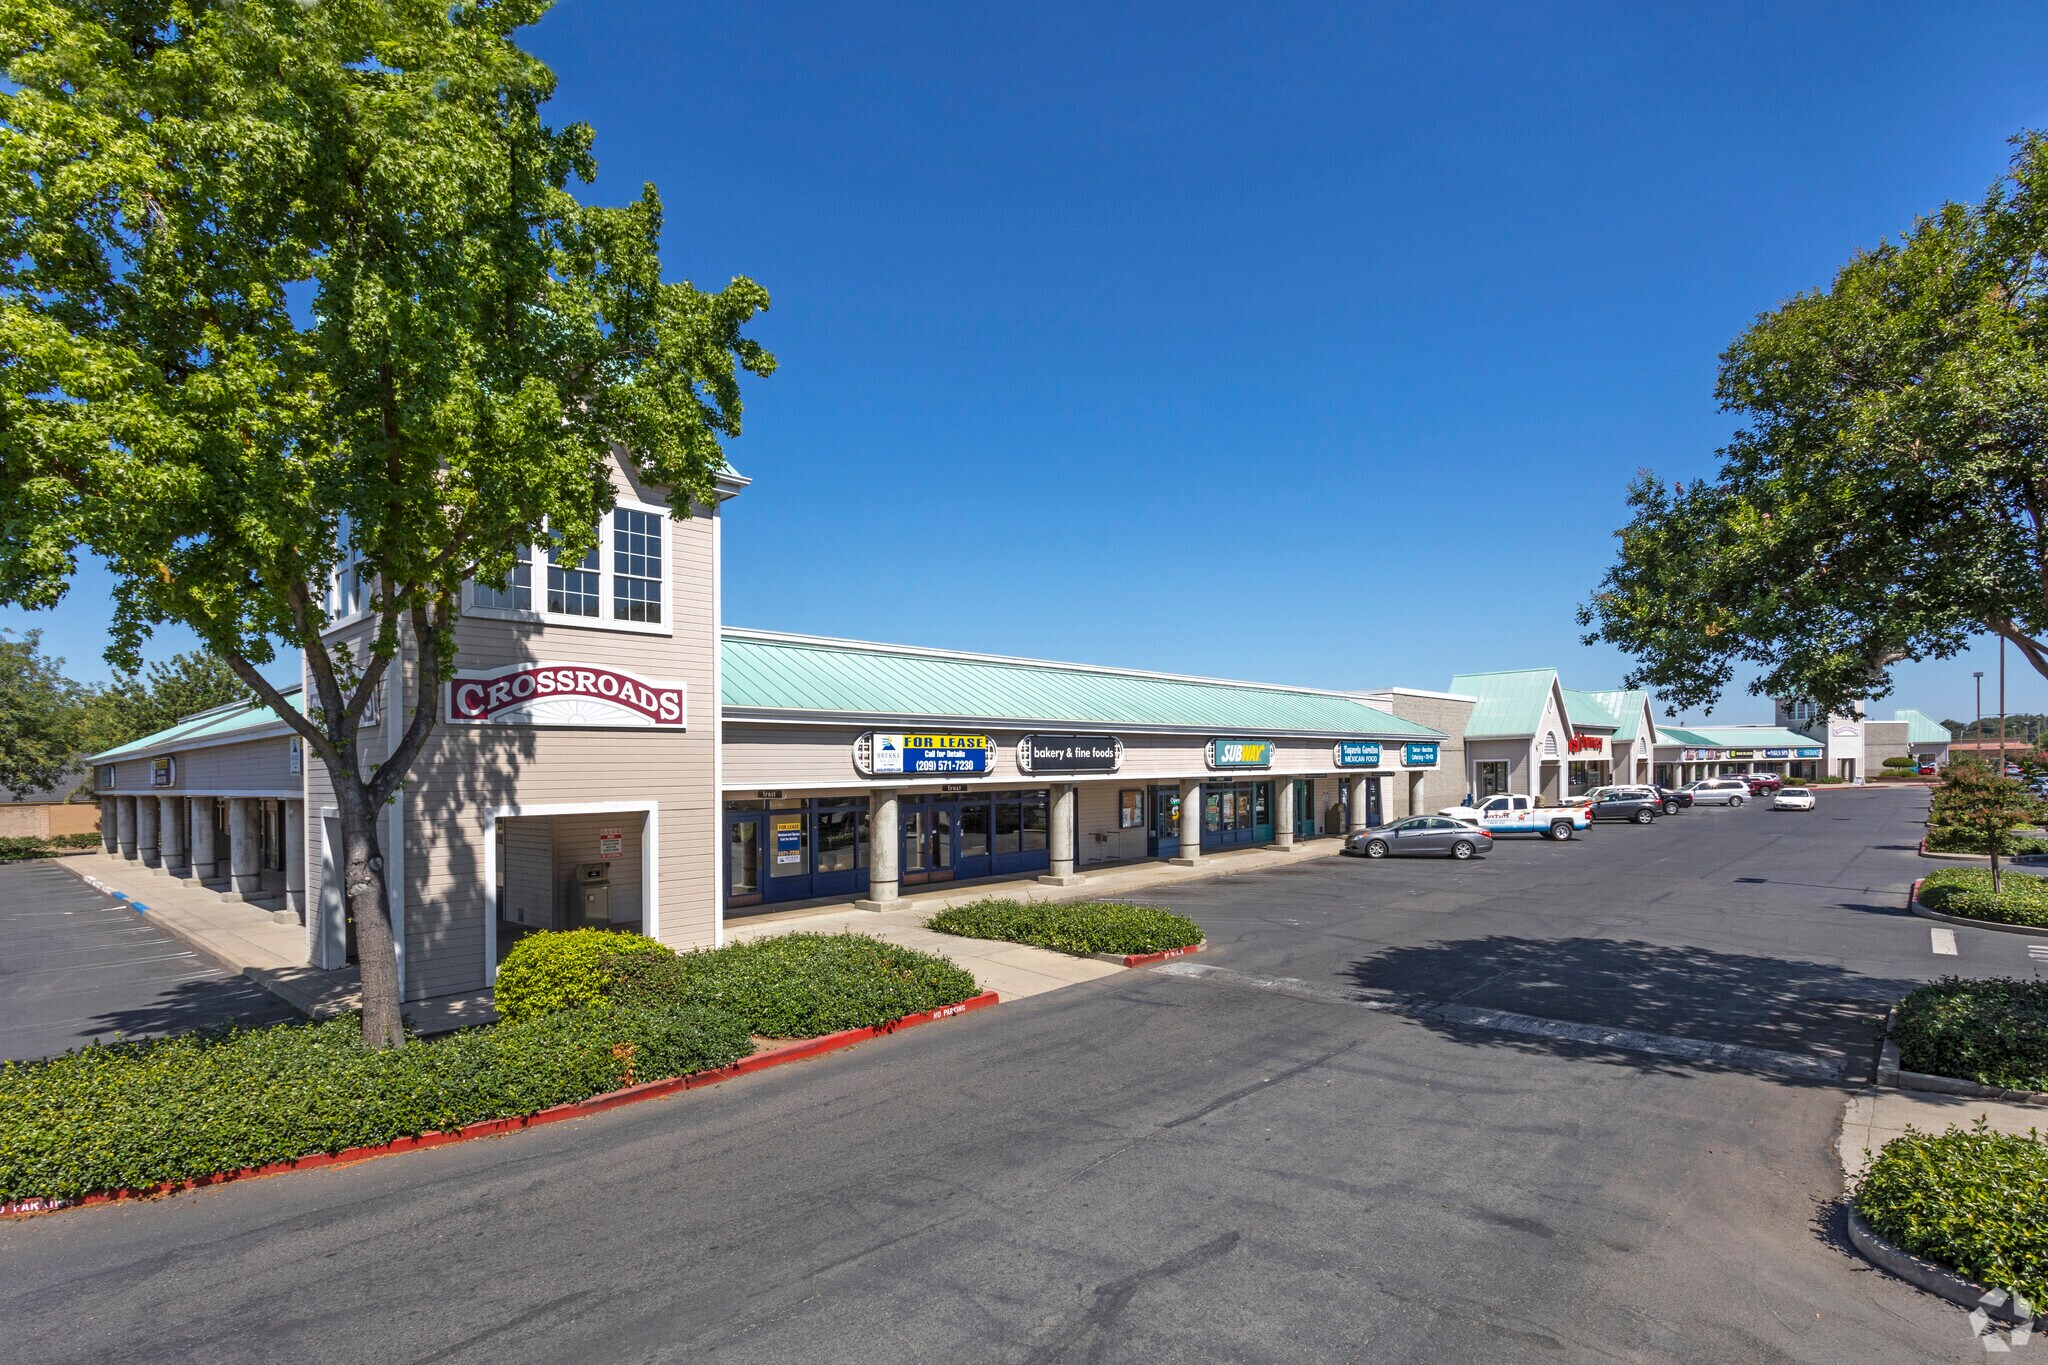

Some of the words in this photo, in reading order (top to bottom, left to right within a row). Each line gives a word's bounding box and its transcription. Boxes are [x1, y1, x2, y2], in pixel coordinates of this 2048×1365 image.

[456, 670, 680, 721] CROSSROADS
[904, 736, 933, 748] FOR
[940, 737, 983, 748] LEASE
[924, 750, 936, 758] Call
[937, 750, 946, 758] for
[946, 750, 966, 758] Details
[1034, 747, 1065, 760] bakery
[1066, 747, 1073, 758] &
[1075, 747, 1090, 758] fine
[1092, 747, 1114, 758] foods
[1221, 744, 1265, 763] SUBWAY
[915, 760, 937, 771] (209)
[938, 760, 974, 771] 571-7230
[933, 1011, 942, 1019] NO
[943, 1004, 966, 1017] PARKING
